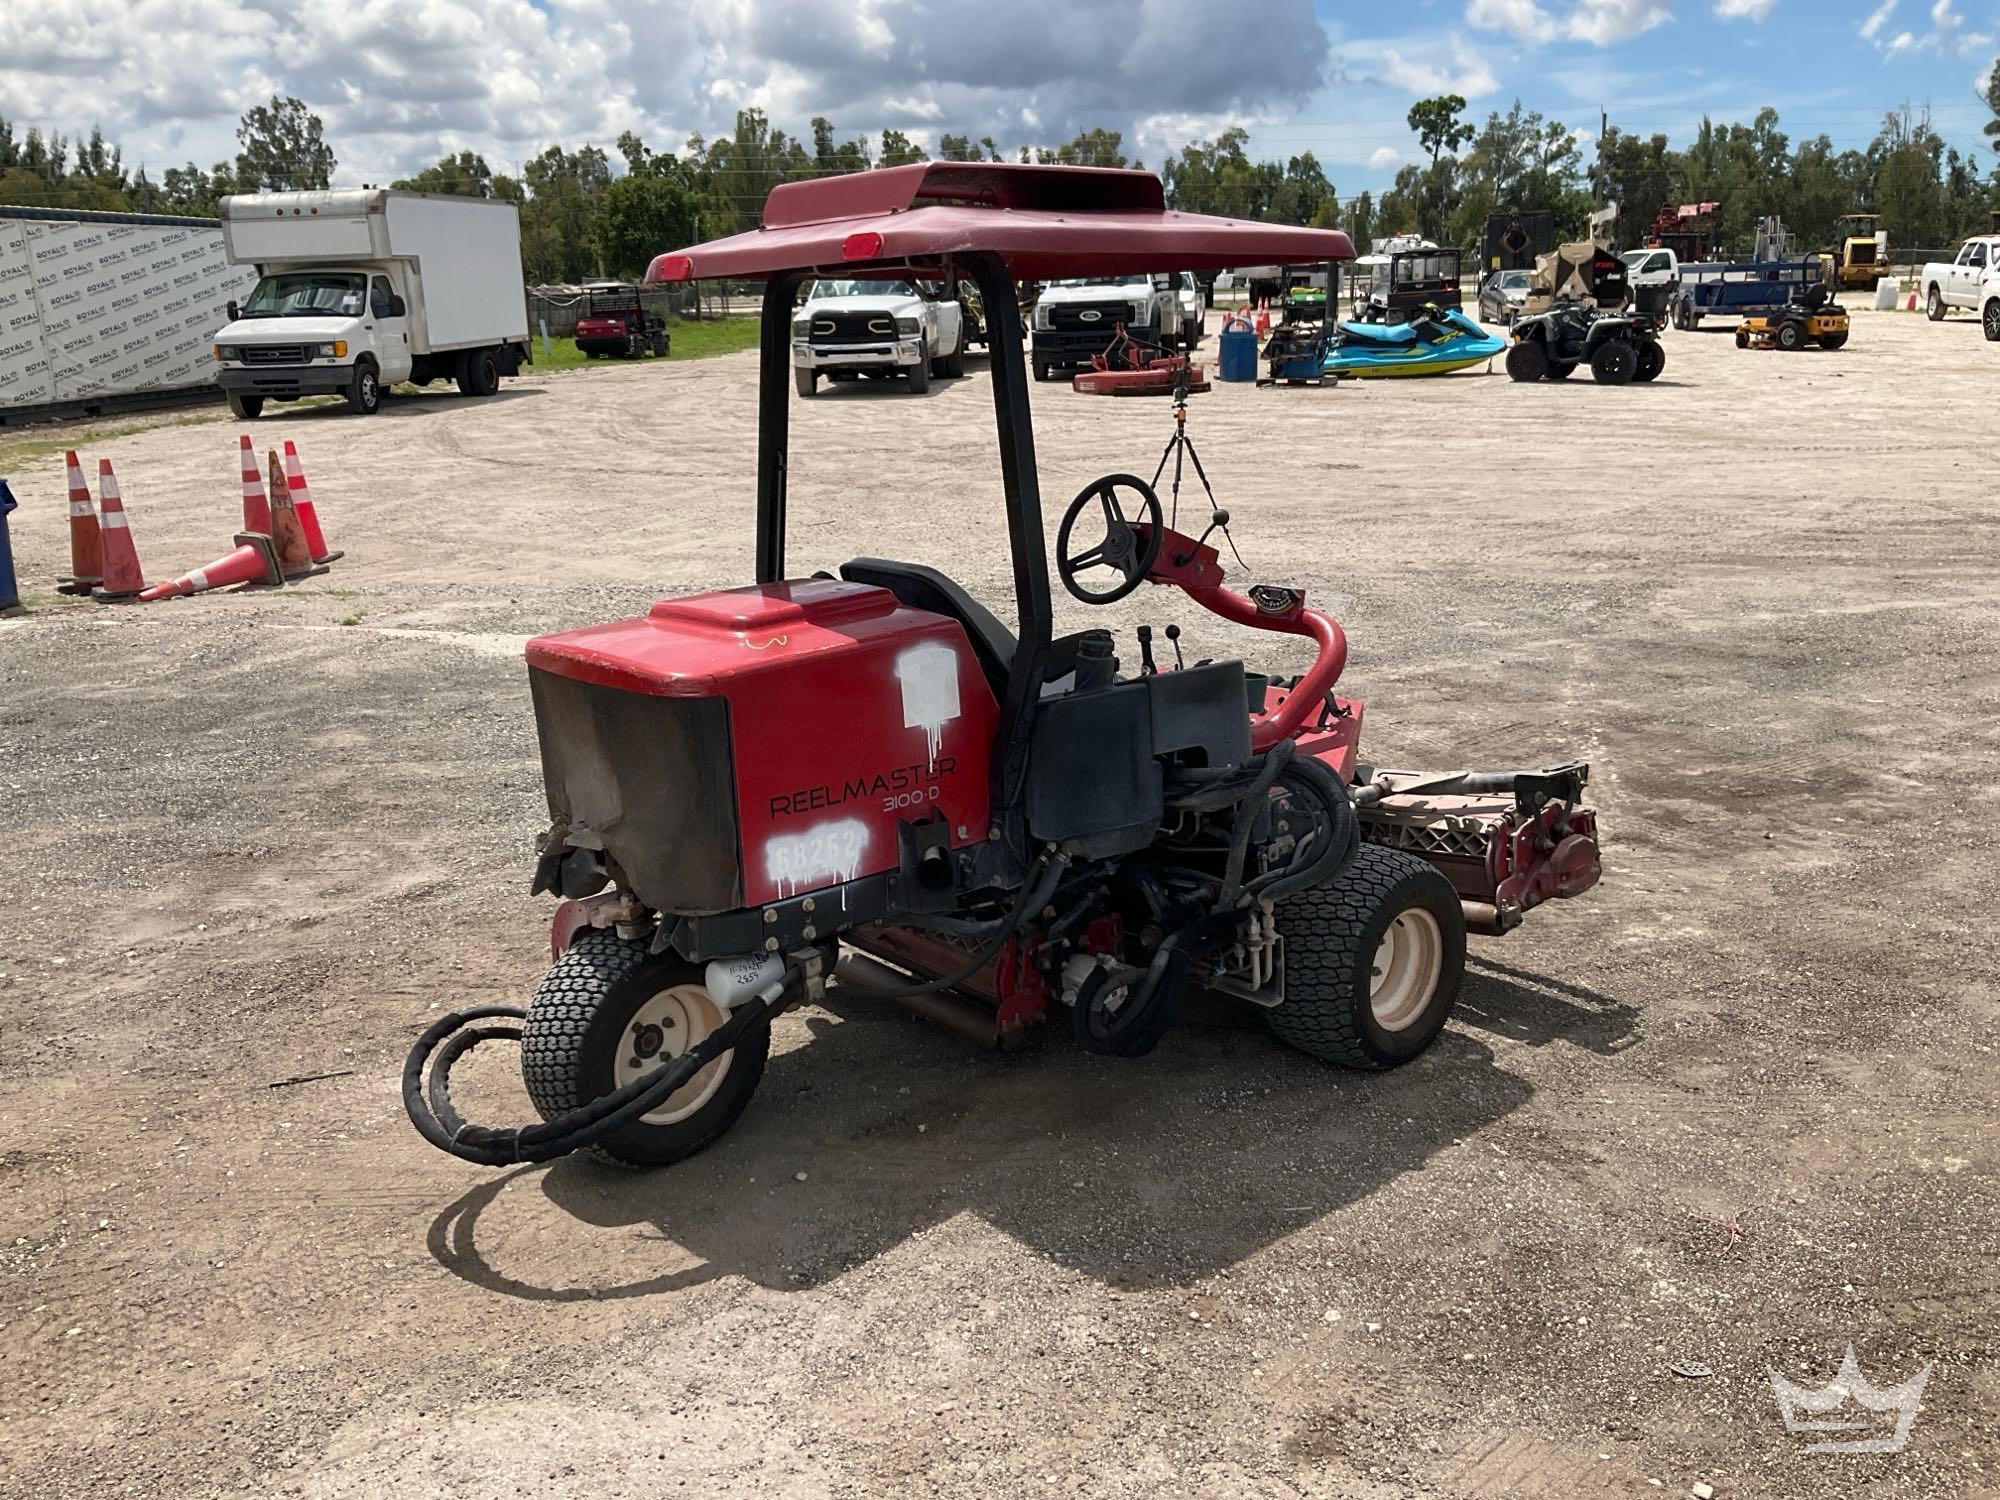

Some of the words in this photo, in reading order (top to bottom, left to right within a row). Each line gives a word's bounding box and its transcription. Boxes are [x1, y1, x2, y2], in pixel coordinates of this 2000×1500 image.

[73, 237, 96, 247] ROYAL
[161, 233, 181, 242] ROYAL
[36, 248, 61, 258] ROYAL
[130, 243, 151, 252] ROYAL
[99, 253, 120, 264] ROYAL
[181, 249, 200, 258] ROYAL
[63, 265, 86, 275] ROYAL
[151, 260, 171, 269] ROYAL
[202, 264, 220, 273] ROYAL
[121, 270, 141, 280] ROYAL
[174, 275, 192, 284] ROYAL
[87, 280, 109, 292] ROYAL
[220, 278, 238, 288] ROYAL
[143, 285, 163, 295] ROYAL
[193, 289, 211, 298] ROYAL
[50, 294, 74, 304] ROYAL
[112, 296, 132, 308] ROYAL
[164, 300, 182, 310] ROYAL
[10, 313, 37, 326] ROYAL
[76, 309, 99, 320] ROYAL
[133, 312, 153, 323] ROYAL
[185, 314, 203, 324] ROYAL
[99, 324, 121, 336] ROYAL
[155, 326, 175, 337] ROYAL
[64, 337, 86, 350] ROYAL
[123, 339, 144, 350] ROYAL
[175, 340, 193, 351] ROYAL
[0, 343, 25, 356] ROYAL
[89, 351, 111, 364] ROYAL
[144, 353, 164, 364] ROYAL
[112, 366, 133, 379] ROYAL
[166, 366, 185, 377] ROYAL
[77, 381, 100, 393] ROYAL
[135, 380, 155, 392] ROYAL
[14, 389, 39, 402] ROYAL
[769, 756, 957, 819] REELMASTER
